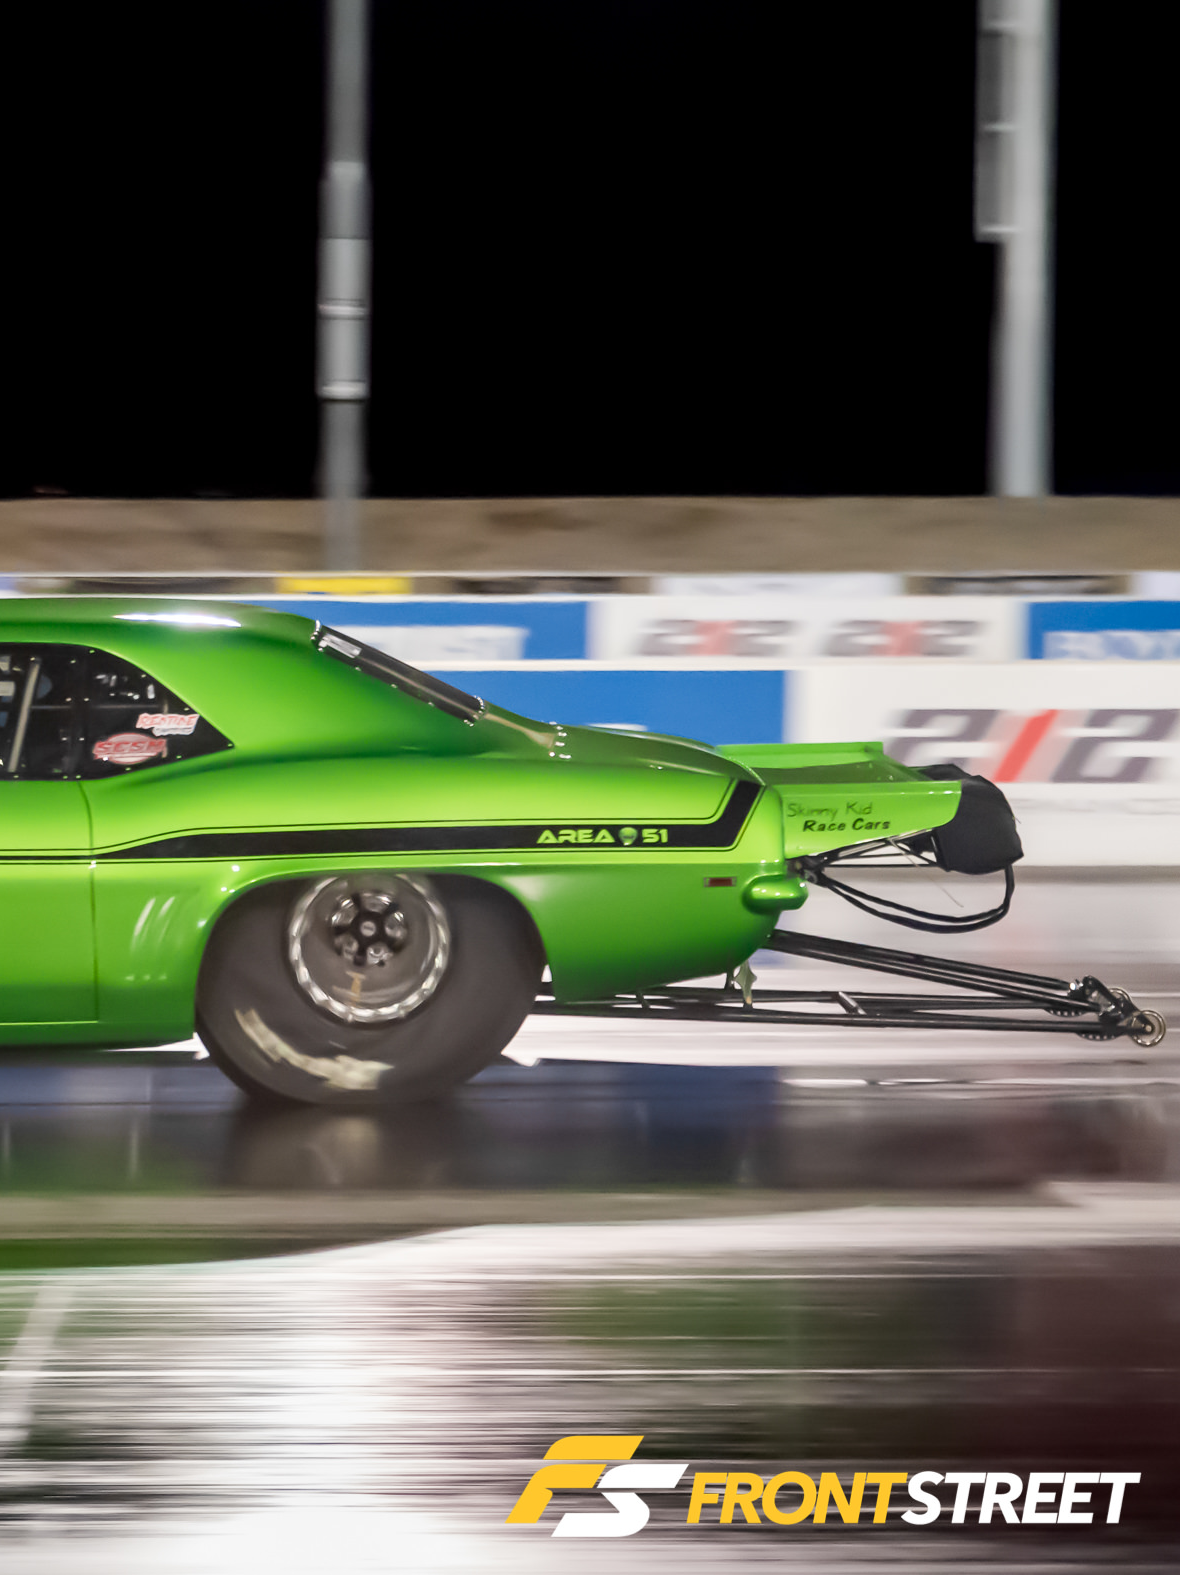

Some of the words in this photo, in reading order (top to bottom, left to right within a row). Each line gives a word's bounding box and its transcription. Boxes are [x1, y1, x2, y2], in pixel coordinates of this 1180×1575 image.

[846, 801, 873, 815] Kid
[802, 820, 846, 832] Race
[852, 818, 891, 831] Cars
[536, 828, 616, 844] AREA
[641, 828, 668, 843] 51
